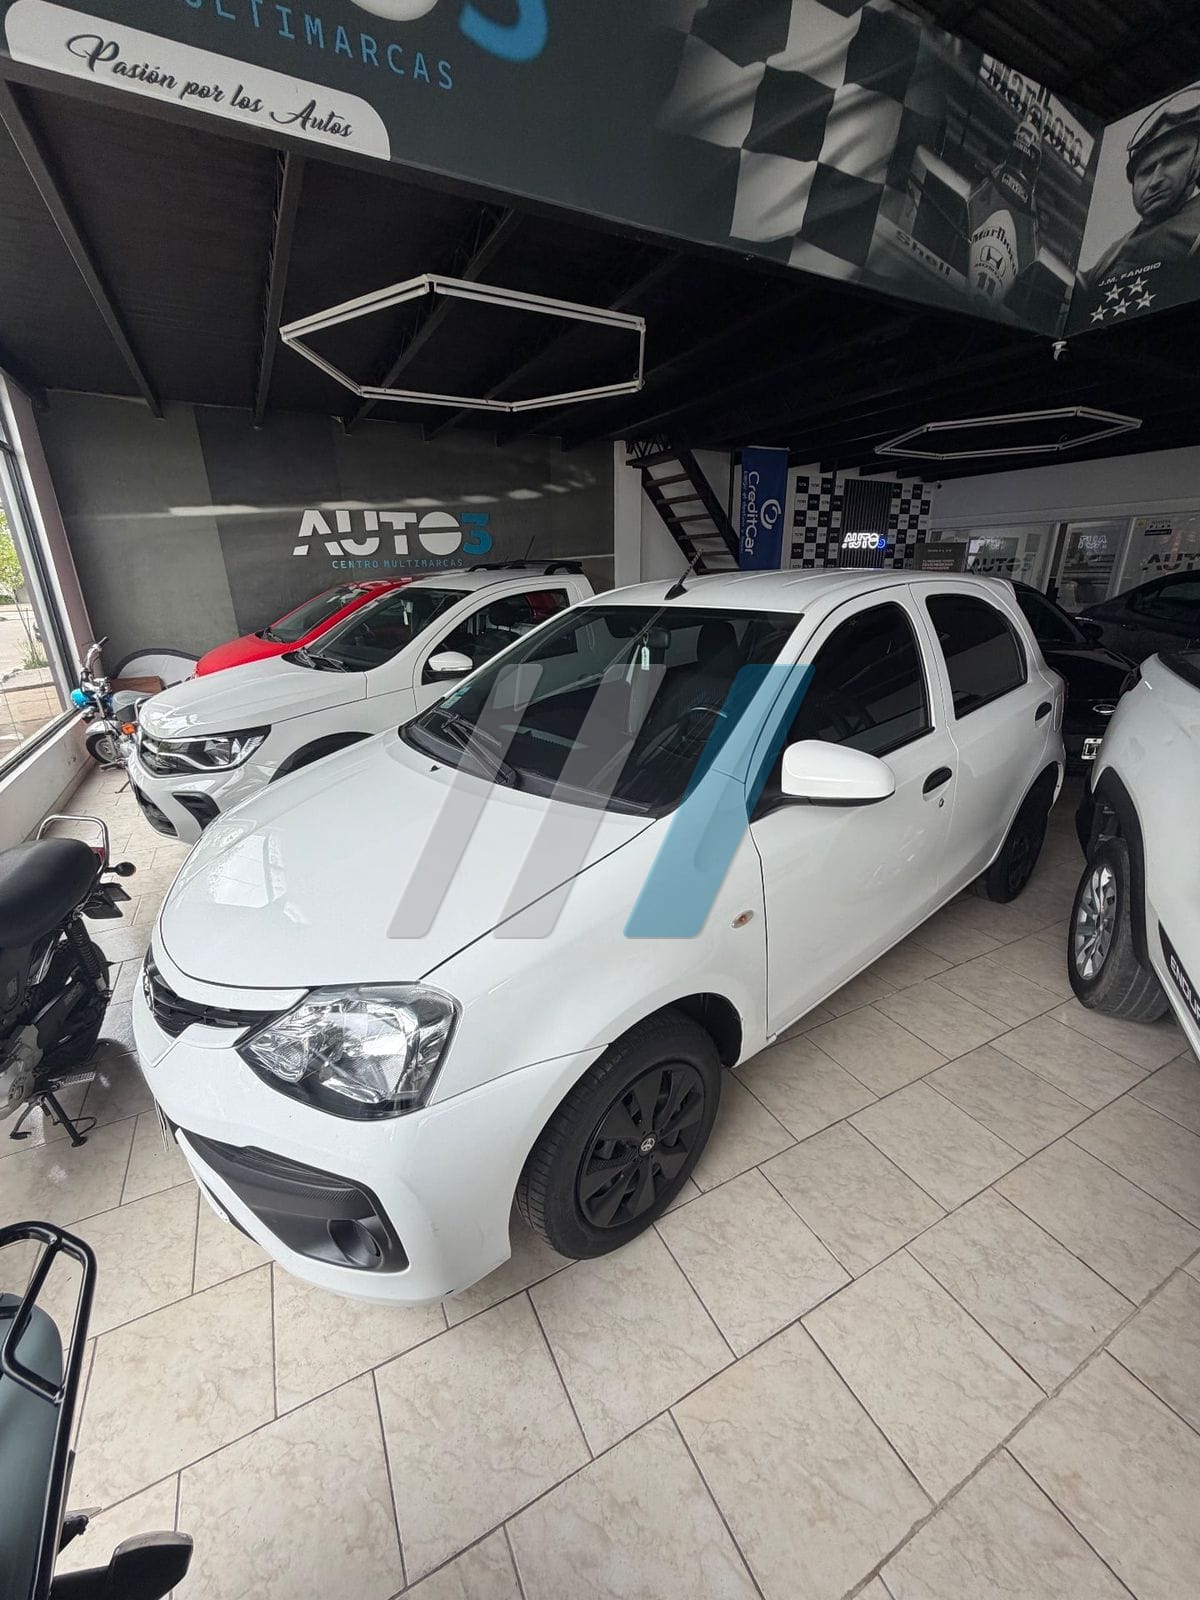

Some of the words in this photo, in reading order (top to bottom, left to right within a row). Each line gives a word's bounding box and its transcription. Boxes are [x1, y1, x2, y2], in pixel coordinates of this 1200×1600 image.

[66, 34, 178, 90] Pasión
[180, 80, 225, 101] por
[230, 84, 264, 113] los
[269, 99, 353, 138] Autos
[292, 509, 494, 556] AUTO3
[745, 470, 760, 555] CreditCar
[332, 560, 378, 569] CENTRO
[383, 558, 463, 569] MULTIMARCAS
